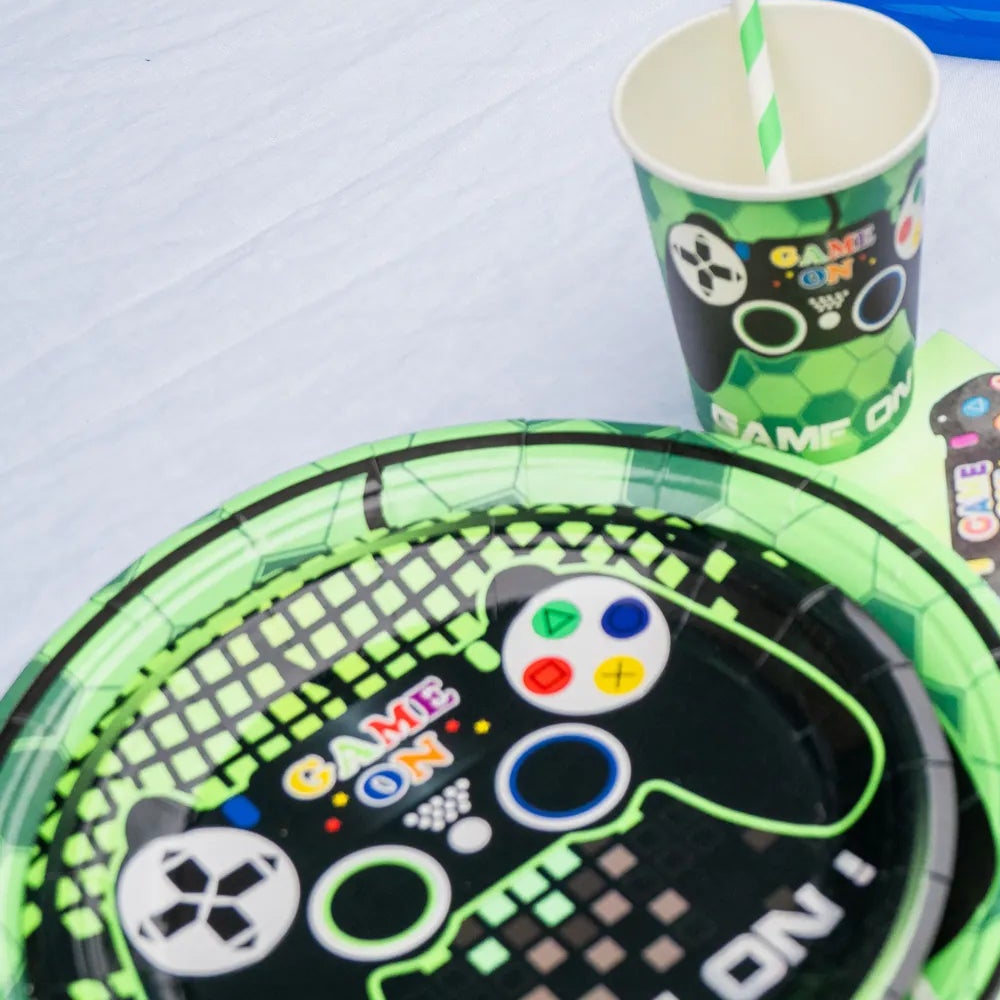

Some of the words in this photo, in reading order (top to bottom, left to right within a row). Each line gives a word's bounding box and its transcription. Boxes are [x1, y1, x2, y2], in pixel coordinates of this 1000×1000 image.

[798, 257, 854, 290] ON
[282, 675, 461, 800] GAME
[354, 730, 455, 808] ON
